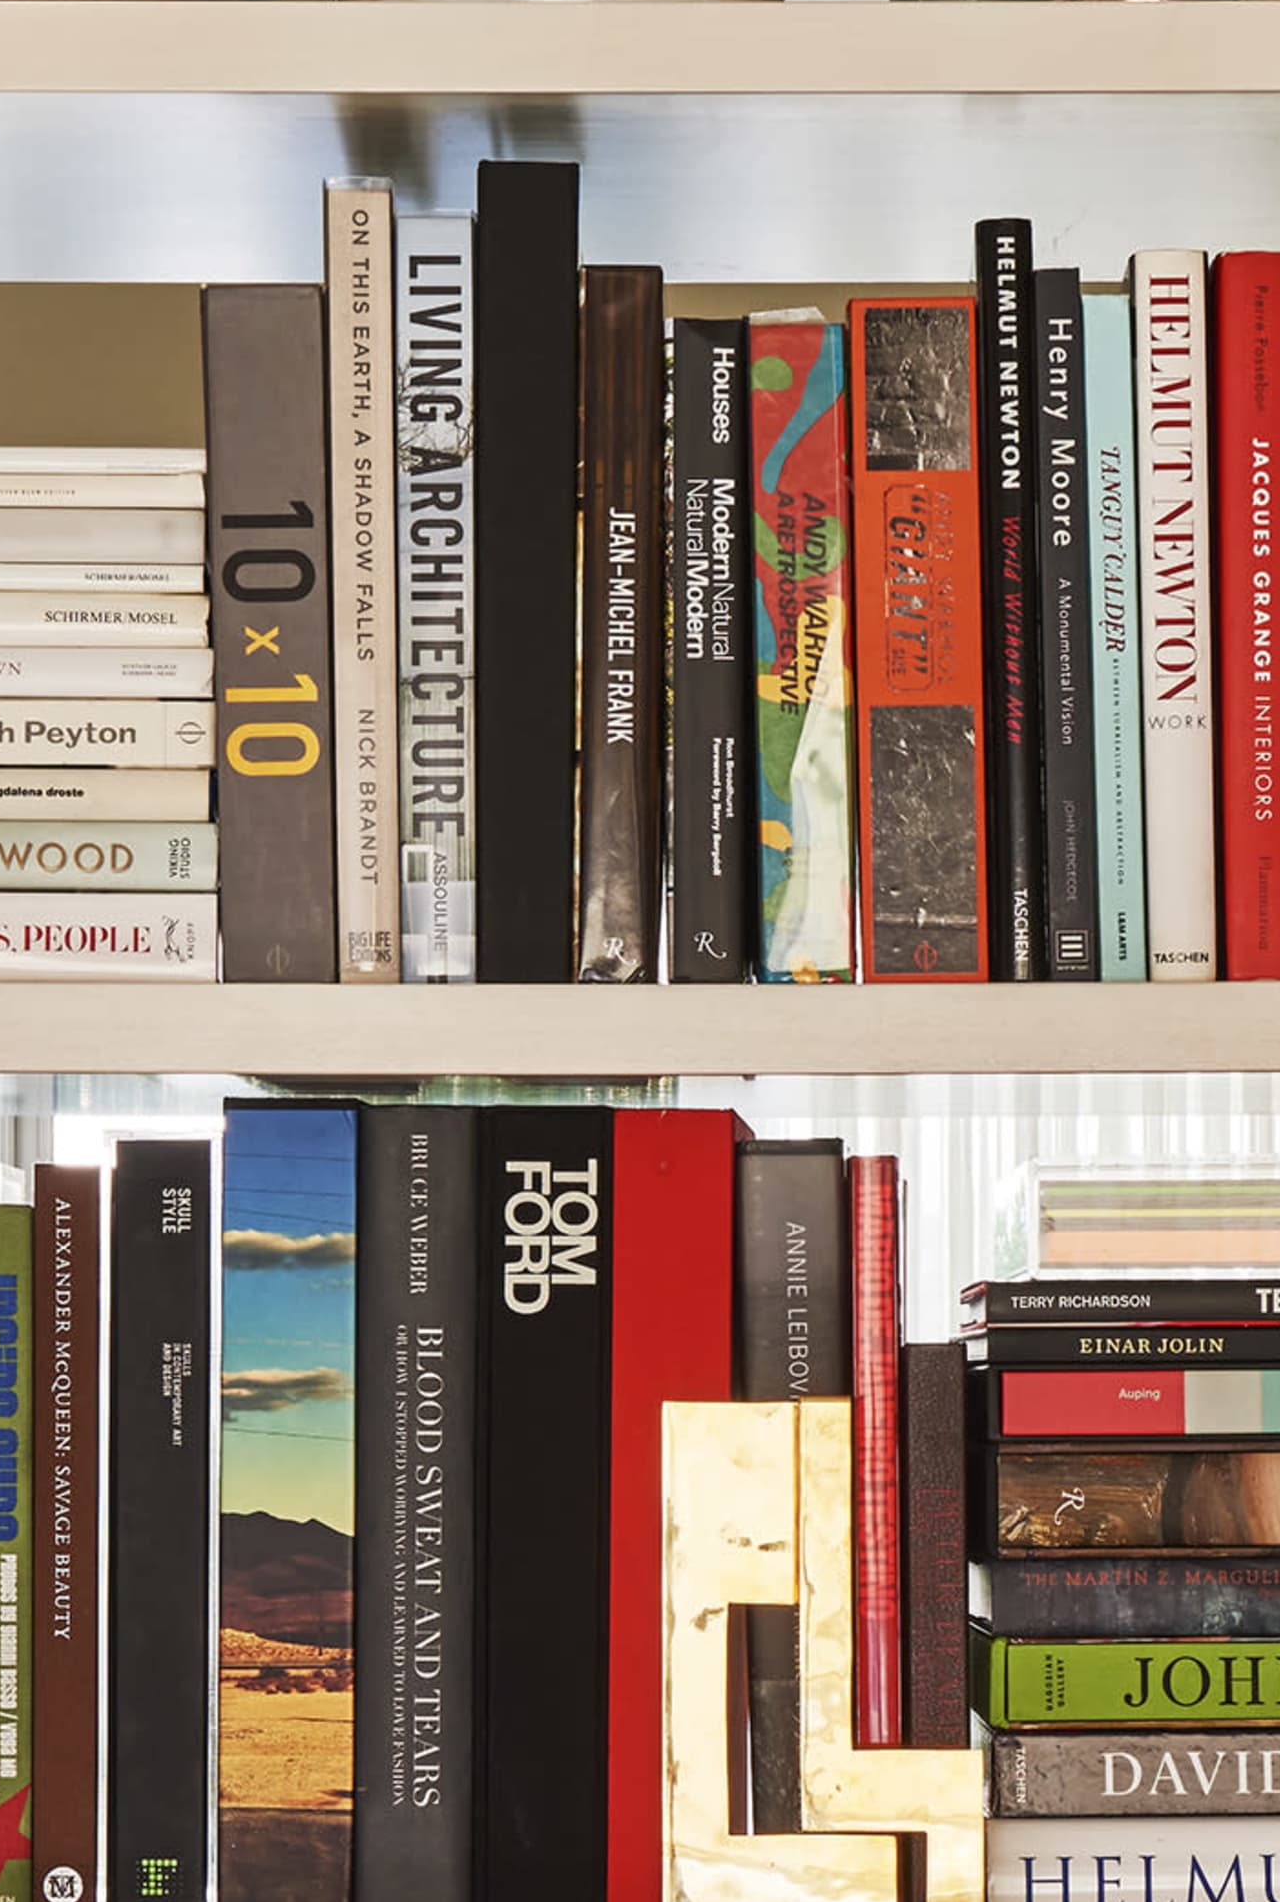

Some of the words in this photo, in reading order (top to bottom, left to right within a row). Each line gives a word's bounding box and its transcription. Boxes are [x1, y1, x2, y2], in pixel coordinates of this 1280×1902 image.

[352, 210, 369, 245] ON
[353, 258, 369, 313] THIS
[997, 237, 1017, 348] HELMUT
[352, 327, 371, 418] EARTH,
[406, 256, 464, 426] LIVING
[1043, 319, 1072, 419] Henry
[1150, 277, 1193, 482] HELMUT
[355, 430, 371, 446] A
[713, 348, 734, 443] Houses
[998, 359, 1021, 490] NEWTON
[355, 459, 372, 571] SHADOW
[776, 489, 797, 508] A
[801, 491, 828, 577] ANDY
[1052, 440, 1072, 545] Moore
[1100, 447, 1122, 548] TANGUY
[1253, 438, 1270, 556] JACQUES
[221, 501, 315, 602] 10
[608, 507, 635, 661] JEAN-MICHEL
[1104, 547, 1126, 652] CALDER
[1154, 500, 1196, 700] NEWTON
[357, 585, 374, 660] FALLS
[406, 442, 467, 838] ARCHITECTURE
[777, 516, 801, 717] RETROSPECTIVE
[1254, 572, 1270, 681] GRANGE
[25, 721, 136, 748] Peyton
[226, 674, 320, 776] 10
[605, 670, 637, 747] FRANK
[45, 788, 83, 797] droste
[1255, 697, 1272, 820] INTERIORS
[24, 926, 150, 952] PEOPLE
[1155, 953, 1209, 963] TASCHEN
[162, 1187, 177, 1235] STYLE
[177, 1187, 192, 1234] SKULL
[411, 1135, 428, 1217] BRUCE
[550, 1156, 600, 1288] TOM
[56, 1198, 71, 1332] ALEXANDER
[410, 1221, 427, 1293] WEBER
[503, 1159, 552, 1316] FORD
[783, 1222, 808, 1298] ANNIE
[1011, 1296, 1058, 1308] TERRY
[1061, 1293, 1150, 1309] RICHARDSON
[1080, 1339, 1150, 1353] EINAR
[1157, 1338, 1223, 1353] JOLIN
[53, 1341, 71, 1456] McQUEEN:
[416, 1329, 443, 1452] BLOOD
[1119, 1389, 1160, 1401] Auping
[55, 1466, 70, 1545] SAVAGE
[415, 1466, 442, 1589] SWEAT
[54, 1554, 70, 1639] BEAUTY
[1025, 1572, 1059, 1587] THE
[1065, 1570, 1149, 1587] MARTIN
[1157, 1569, 1176, 1586] Z.
[415, 1604, 440, 1677] AND
[414, 1689, 440, 1806] TEARS
